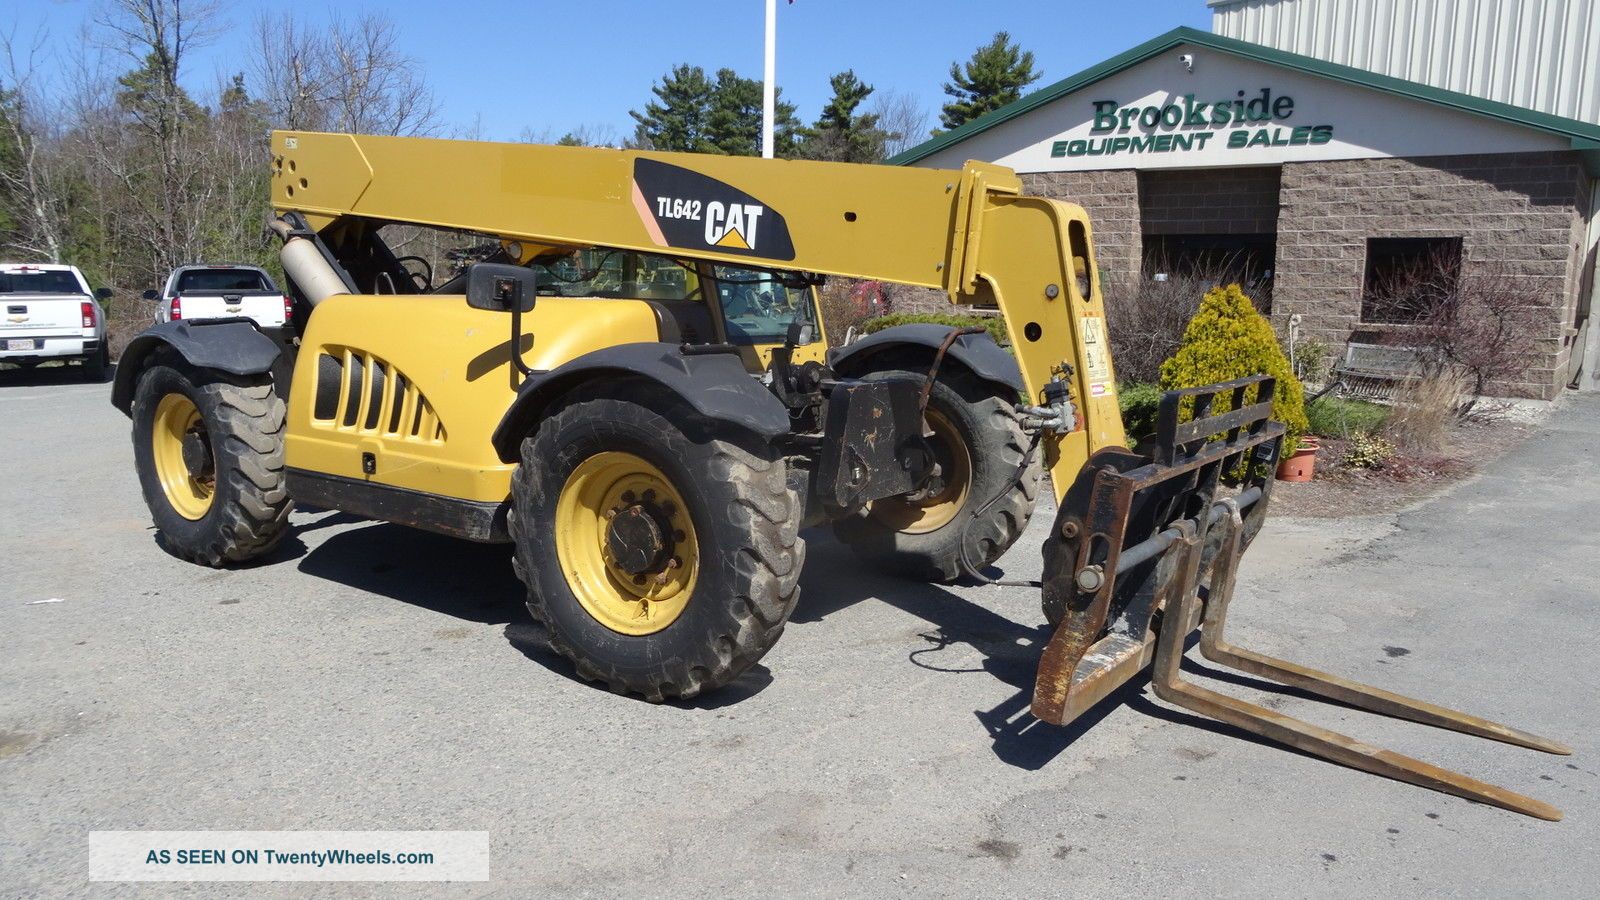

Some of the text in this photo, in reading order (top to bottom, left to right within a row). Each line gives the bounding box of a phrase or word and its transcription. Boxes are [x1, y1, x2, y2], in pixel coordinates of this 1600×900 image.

[1091, 88, 1294, 132] Brookside
[1050, 125, 1334, 158] EQUIPMENT SALES
[657, 197, 763, 250] TL642 CAT
